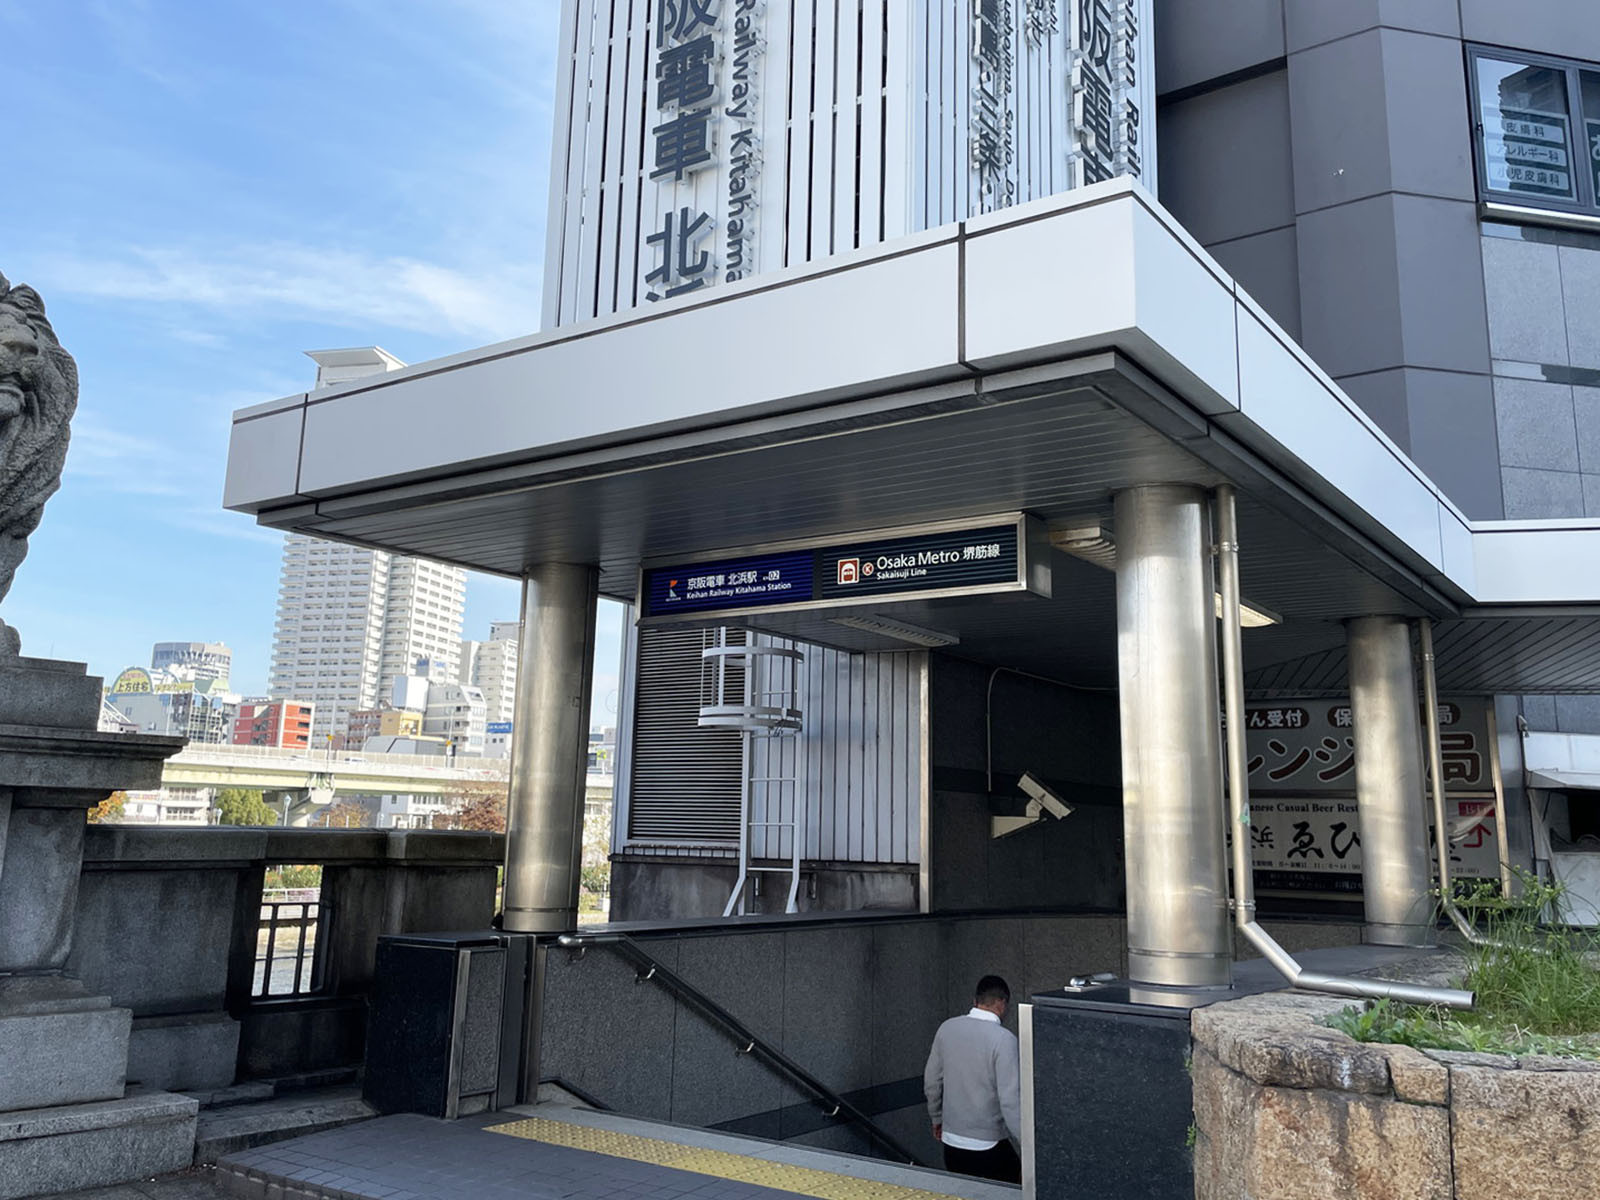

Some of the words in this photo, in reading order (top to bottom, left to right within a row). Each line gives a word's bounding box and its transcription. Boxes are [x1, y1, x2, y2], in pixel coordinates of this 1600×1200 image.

[1126, 97, 1142, 179] Rail
[876, 554, 916, 570] Osaka
[917, 550, 960, 566] Metro
[962, 543, 1001, 561] 堺筋線
[687, 574, 726, 591] 京阪電車
[727, 569, 758, 586] 北浜駅
[876, 568, 910, 581] Sakaisuji
[911, 567, 927, 577] Line
[686, 589, 709, 600] Keihan
[708, 588, 735, 598] Railway
[735, 584, 767, 595] Kitahama
[767, 581, 792, 591] Station
[1276, 803, 1309, 813] Casual
[1311, 803, 1334, 813] Beer
